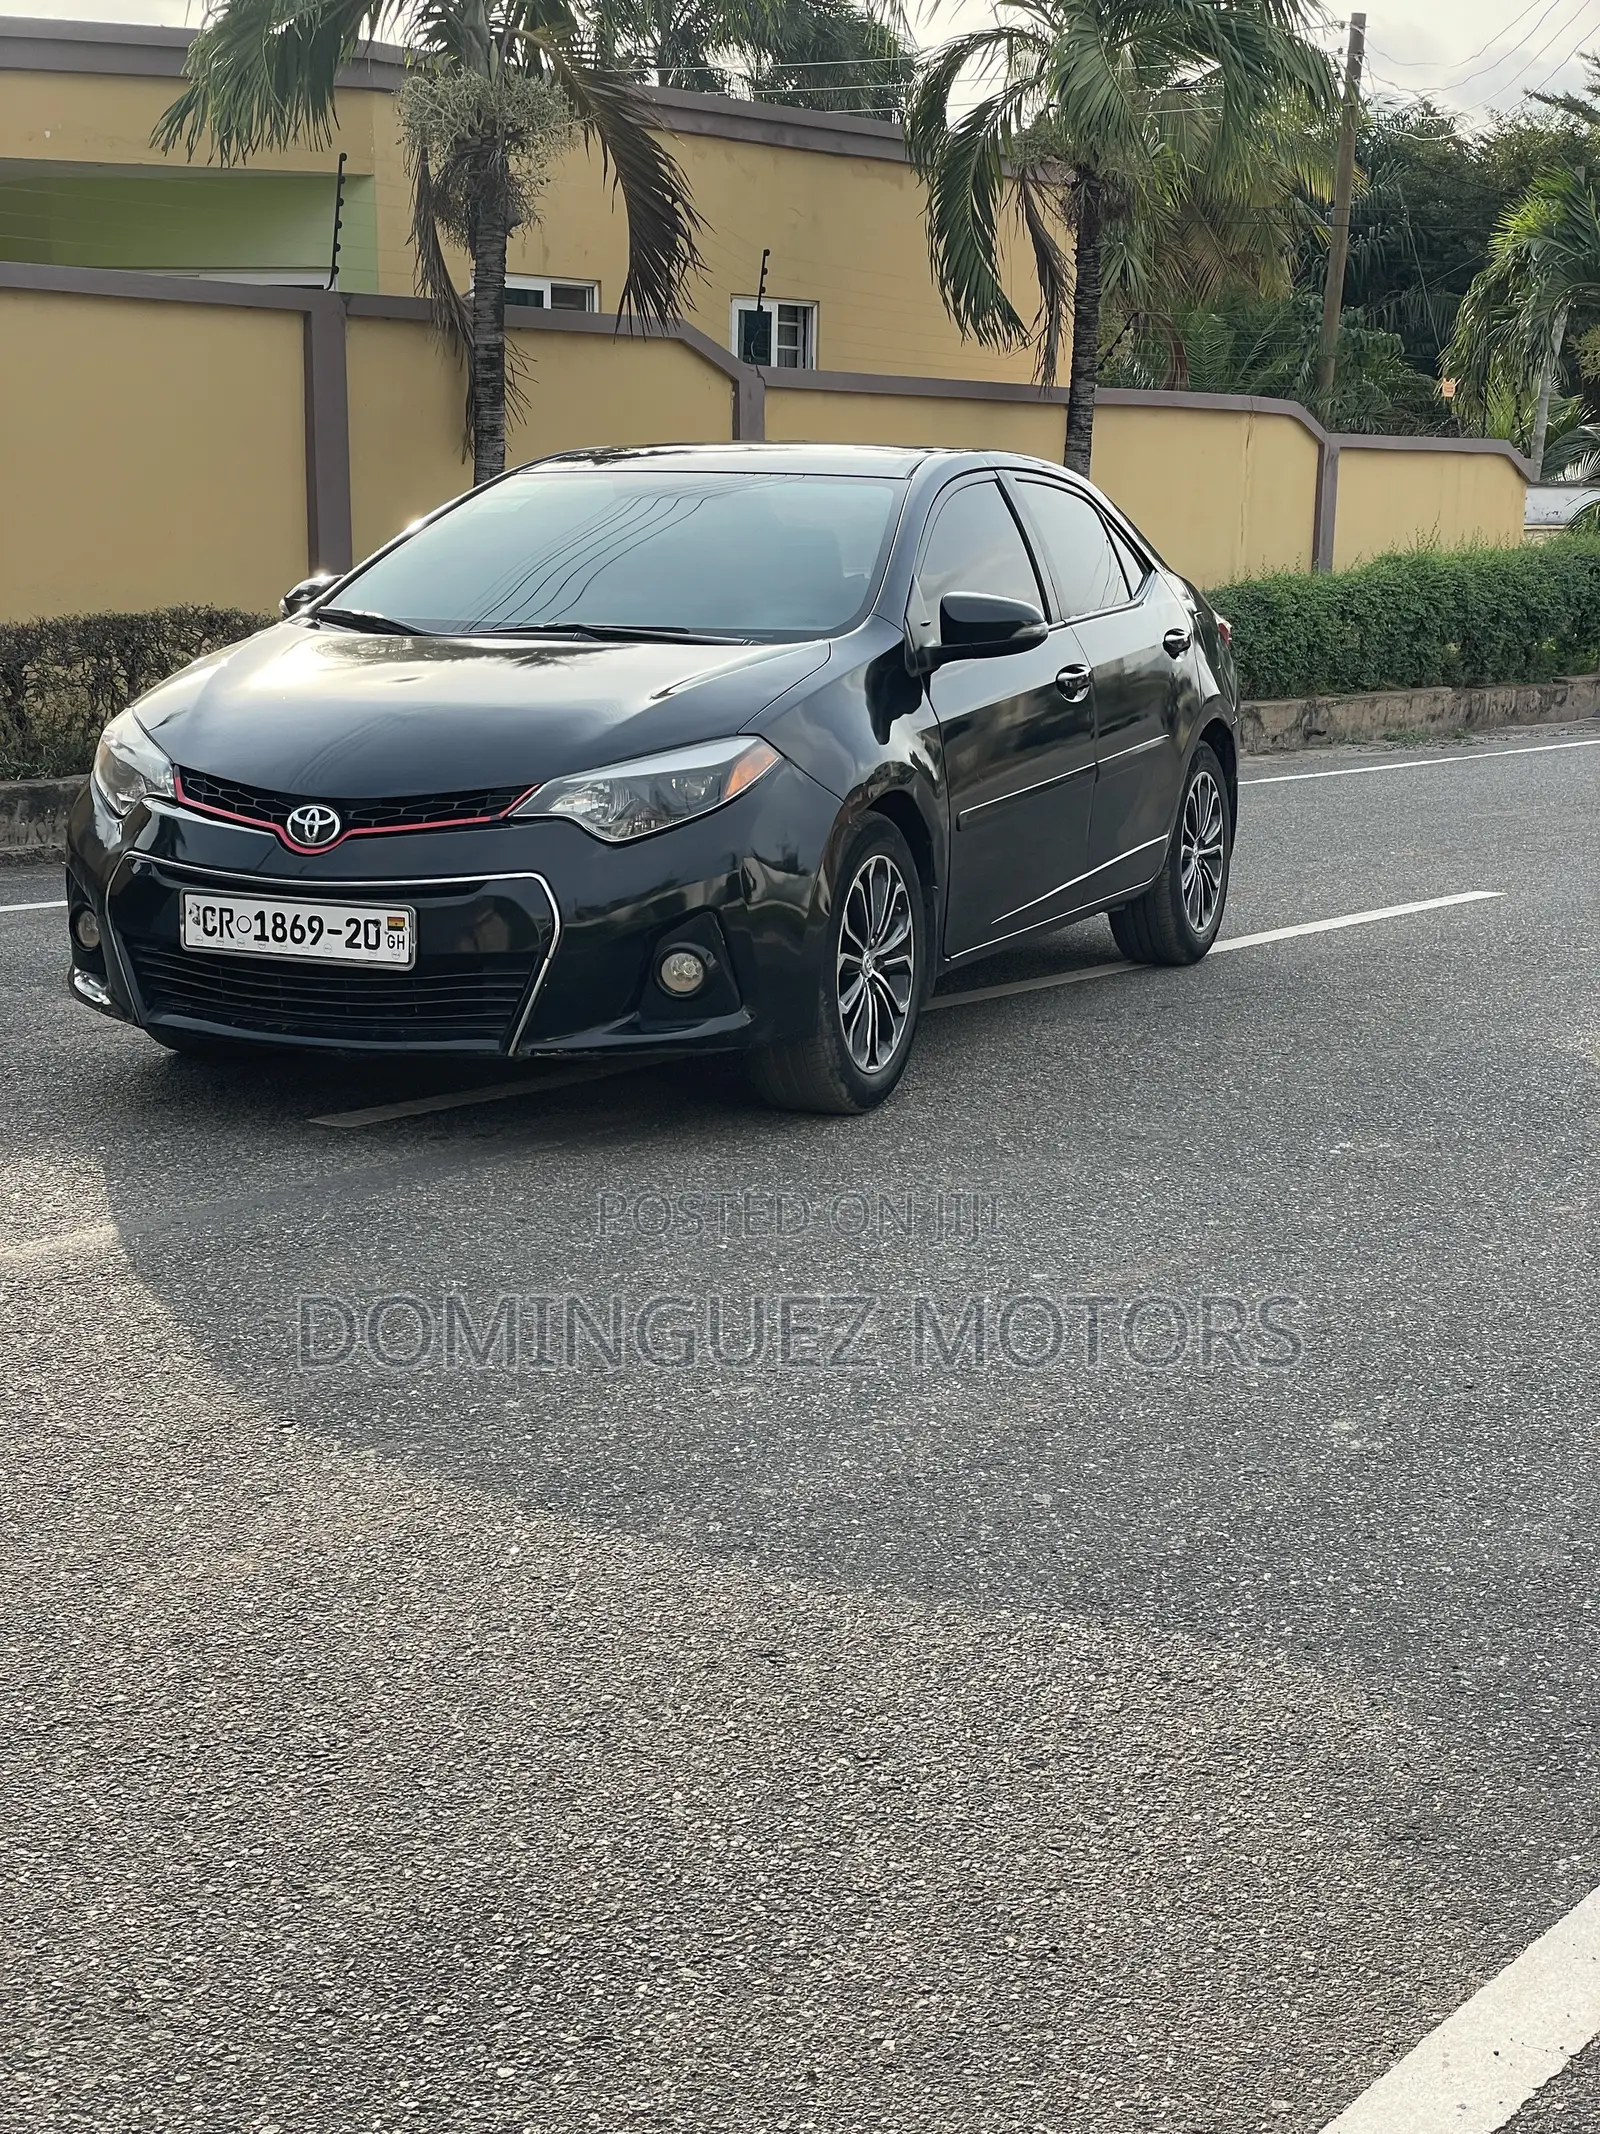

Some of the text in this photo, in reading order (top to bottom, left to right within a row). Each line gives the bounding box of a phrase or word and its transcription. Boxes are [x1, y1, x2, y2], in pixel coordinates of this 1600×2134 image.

[202, 905, 381, 951] CR 1869-20
[387, 934, 405, 951] GH
